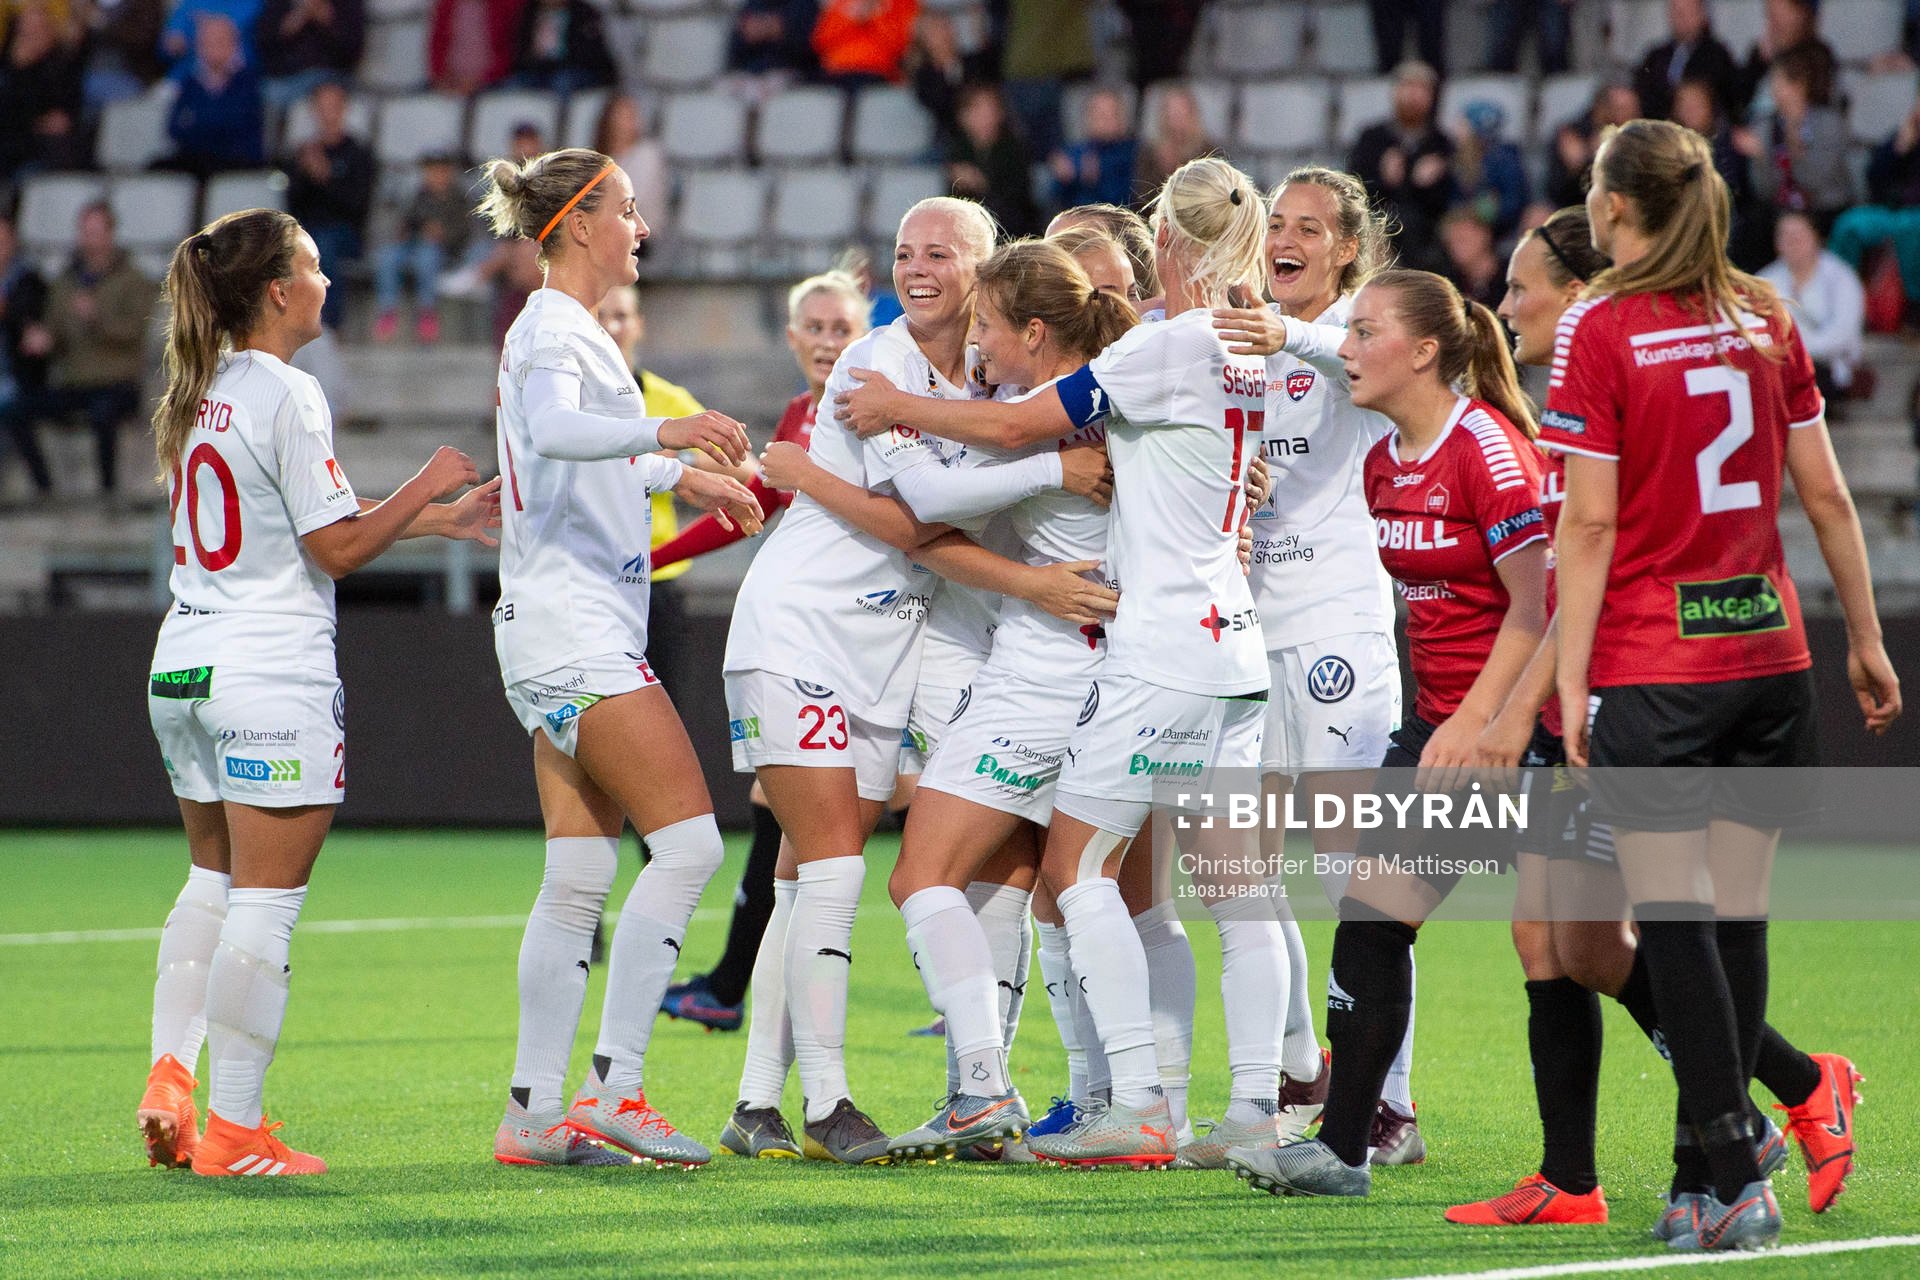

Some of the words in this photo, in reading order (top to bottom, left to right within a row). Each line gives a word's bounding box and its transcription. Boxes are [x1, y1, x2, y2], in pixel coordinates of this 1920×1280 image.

[1288, 378, 1312, 389] FCR
[1684, 364, 1762, 515] 2
[1255, 547, 1314, 564] Sharing
[897, 608, 913, 621] of
[1683, 595, 1753, 620] akea
[244, 729, 297, 741] Damstahl
[798, 704, 849, 751] 23
[1162, 728, 1210, 741] Damstahl
[230, 760, 266, 778] MKB
